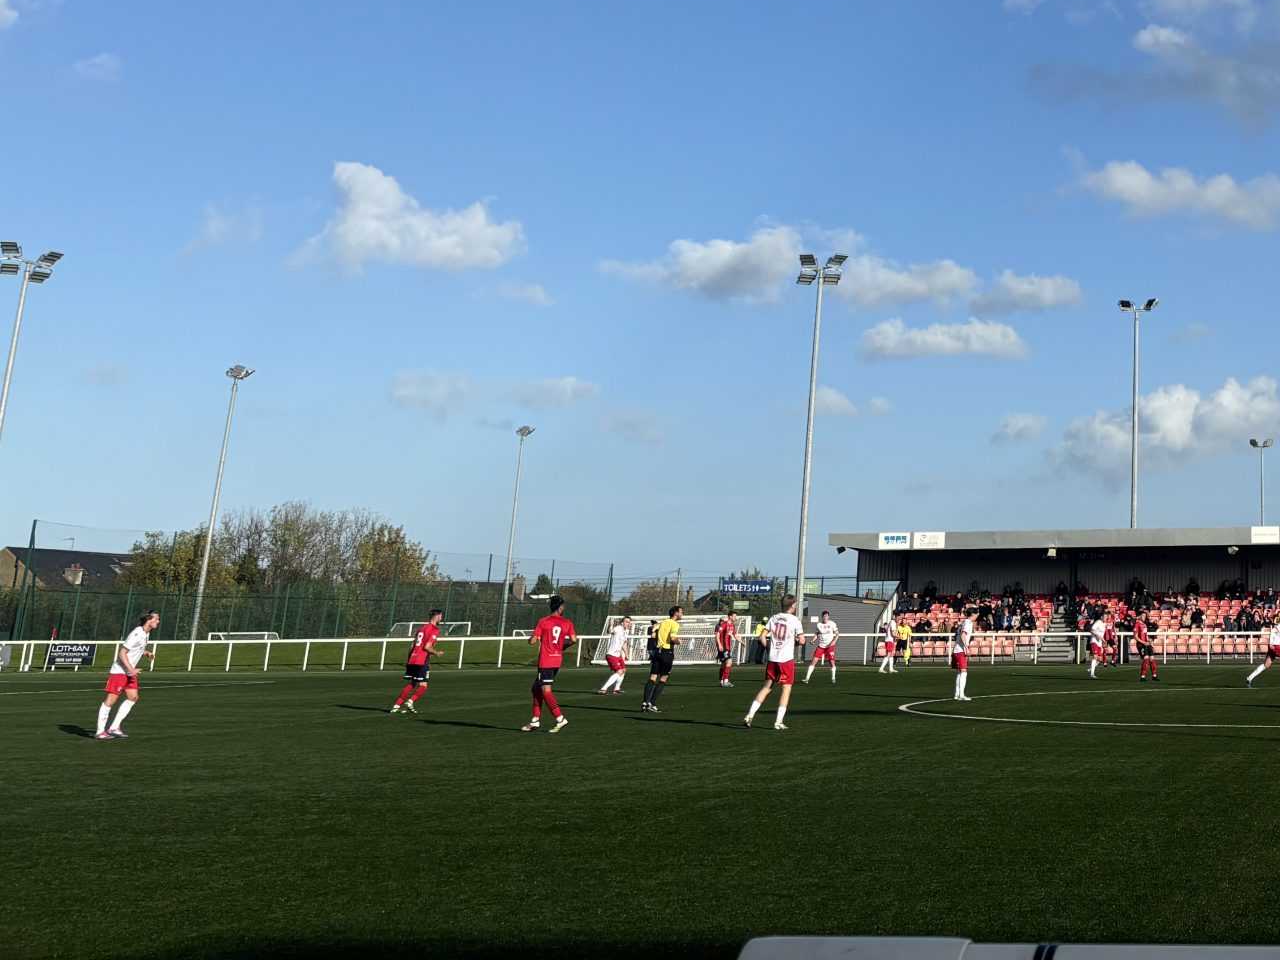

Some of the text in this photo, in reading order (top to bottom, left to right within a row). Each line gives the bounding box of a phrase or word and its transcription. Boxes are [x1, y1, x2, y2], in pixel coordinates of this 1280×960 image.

[724, 583, 752, 592] TOILETS
[552, 625, 562, 644] 9
[773, 623, 787, 641] 10
